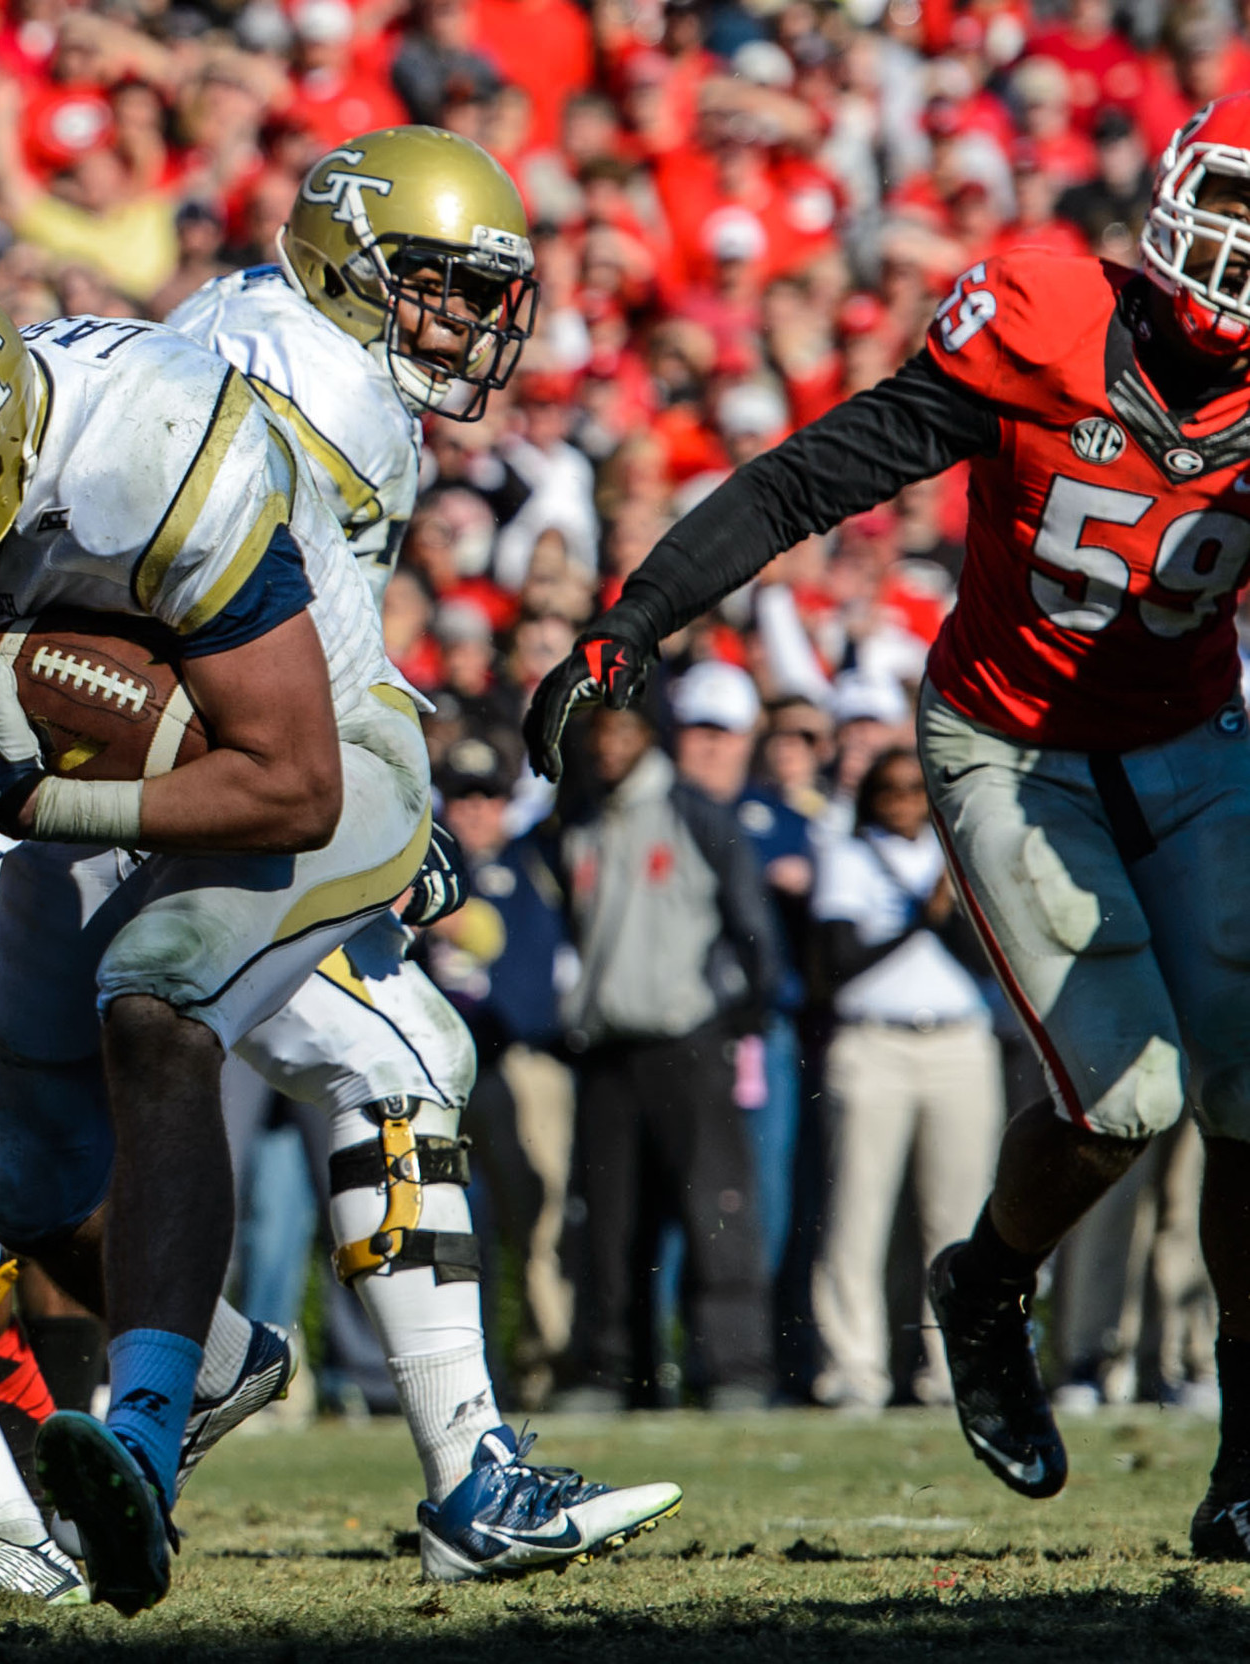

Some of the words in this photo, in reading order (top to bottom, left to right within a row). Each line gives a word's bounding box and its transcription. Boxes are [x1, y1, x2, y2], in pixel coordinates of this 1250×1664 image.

[303, 148, 393, 223] GT
[936, 260, 996, 352] 59
[1074, 419, 1123, 462] SEC
[1030, 473, 1250, 638] 59
